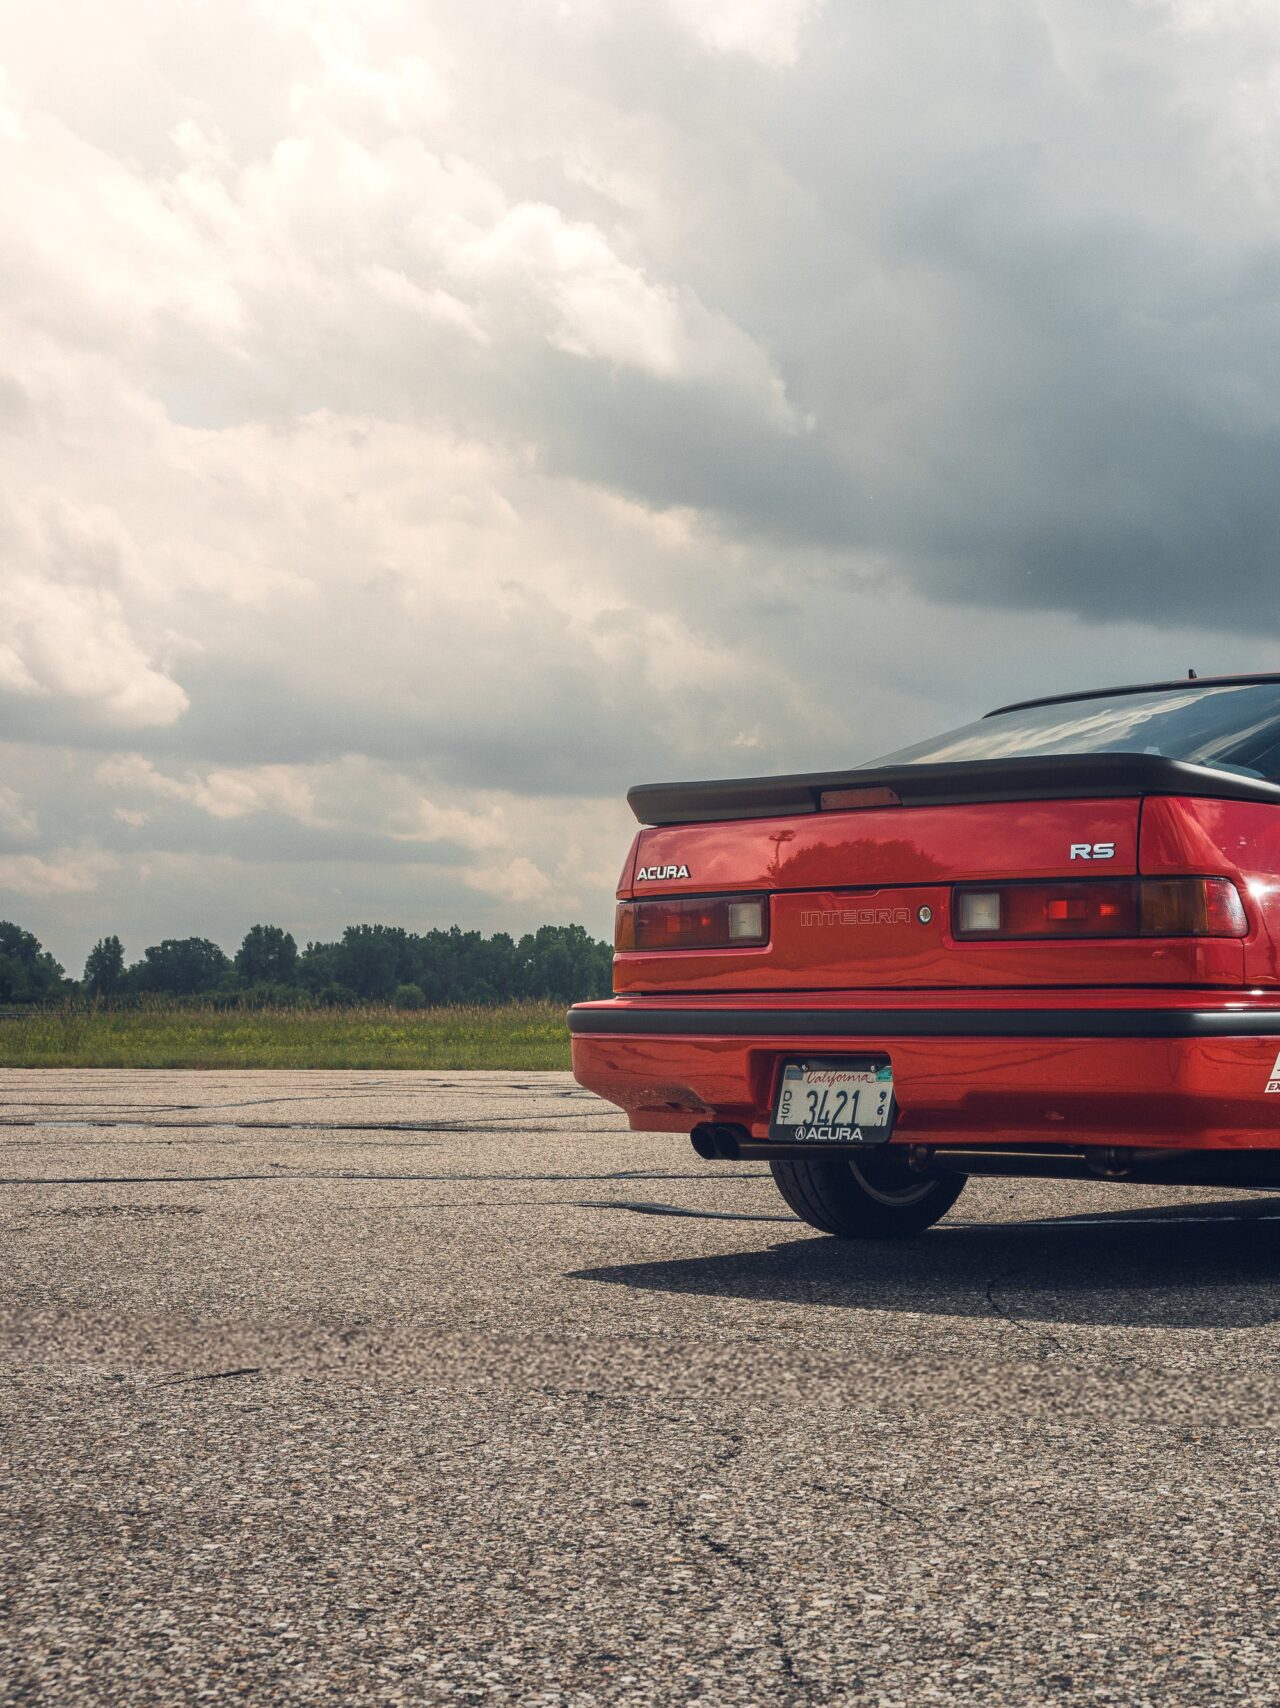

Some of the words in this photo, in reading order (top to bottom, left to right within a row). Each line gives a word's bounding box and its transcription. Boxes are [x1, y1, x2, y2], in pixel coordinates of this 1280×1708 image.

[1070, 843, 1115, 860] RS
[637, 865, 691, 880] ACURA
[800, 907, 911, 927] INTEGRA
[806, 1070, 875, 1088] California
[803, 1089, 860, 1126] 3421
[805, 1127, 863, 1140] ACURA
